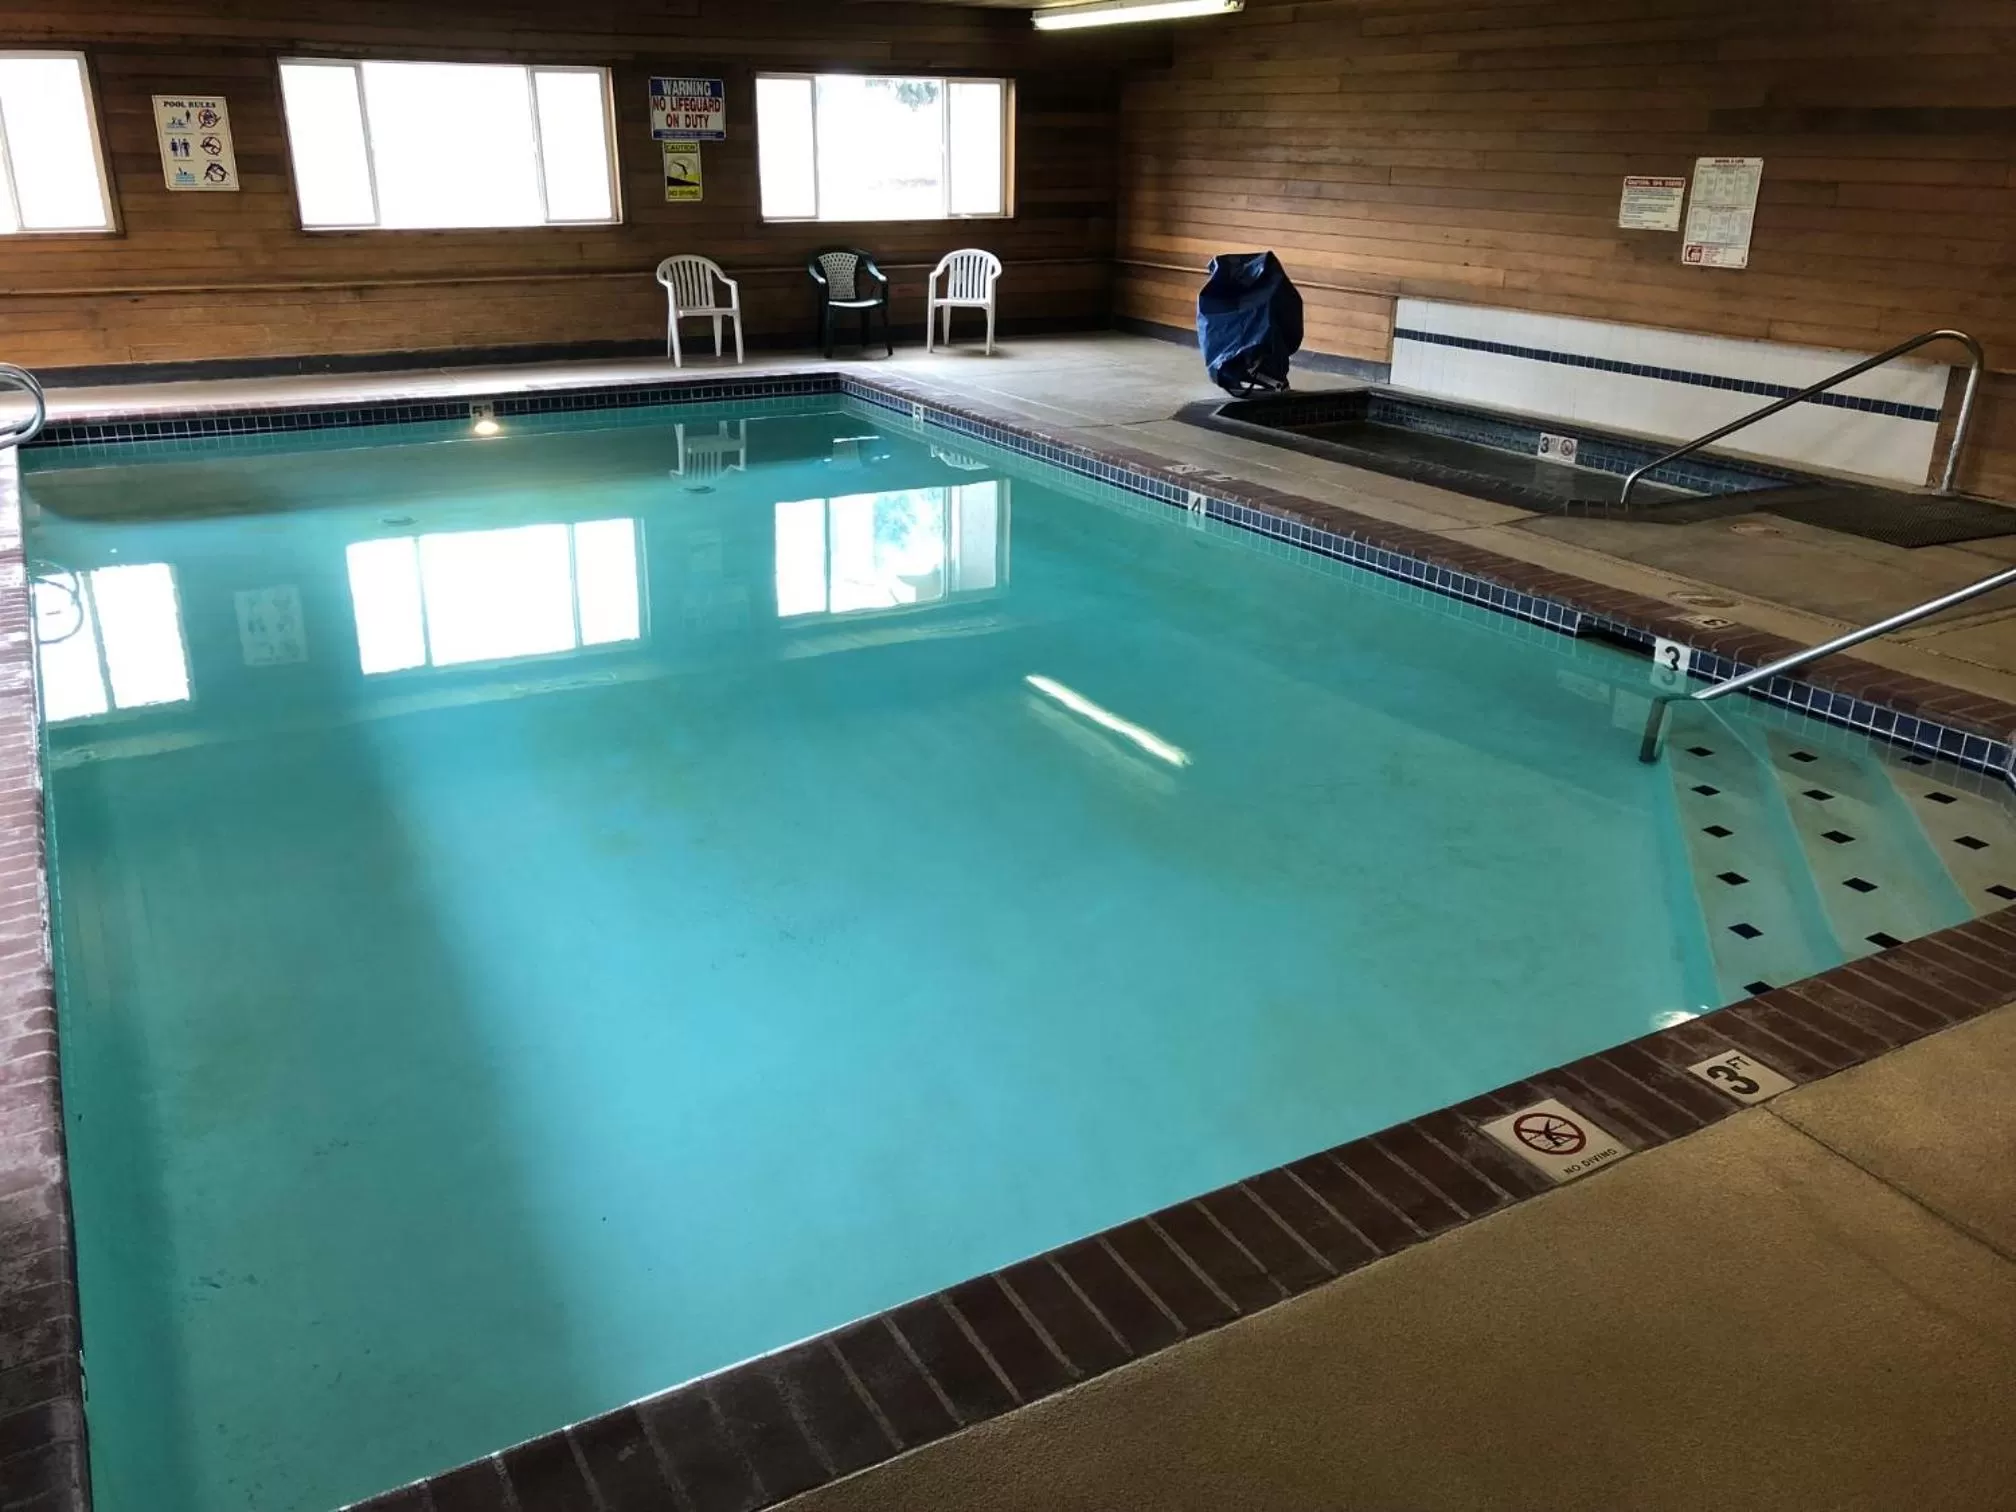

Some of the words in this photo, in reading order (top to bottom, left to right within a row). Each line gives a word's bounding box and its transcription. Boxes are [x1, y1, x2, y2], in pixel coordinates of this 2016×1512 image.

[662, 80, 711, 96] WARNING
[188, 101, 217, 109] RULES
[652, 97, 666, 111] NO
[670, 97, 721, 113] LIFEGUARD
[666, 113, 680, 128] ON
[684, 114, 710, 129] DUTY
[1540, 436, 1550, 454] 3
[1664, 646, 1681, 671] 3
[1726, 1056, 1751, 1071] FT
[1706, 1065, 1760, 1095] 3
[1563, 1164, 1581, 1174] NO
[1580, 1148, 1619, 1167] DIVING
